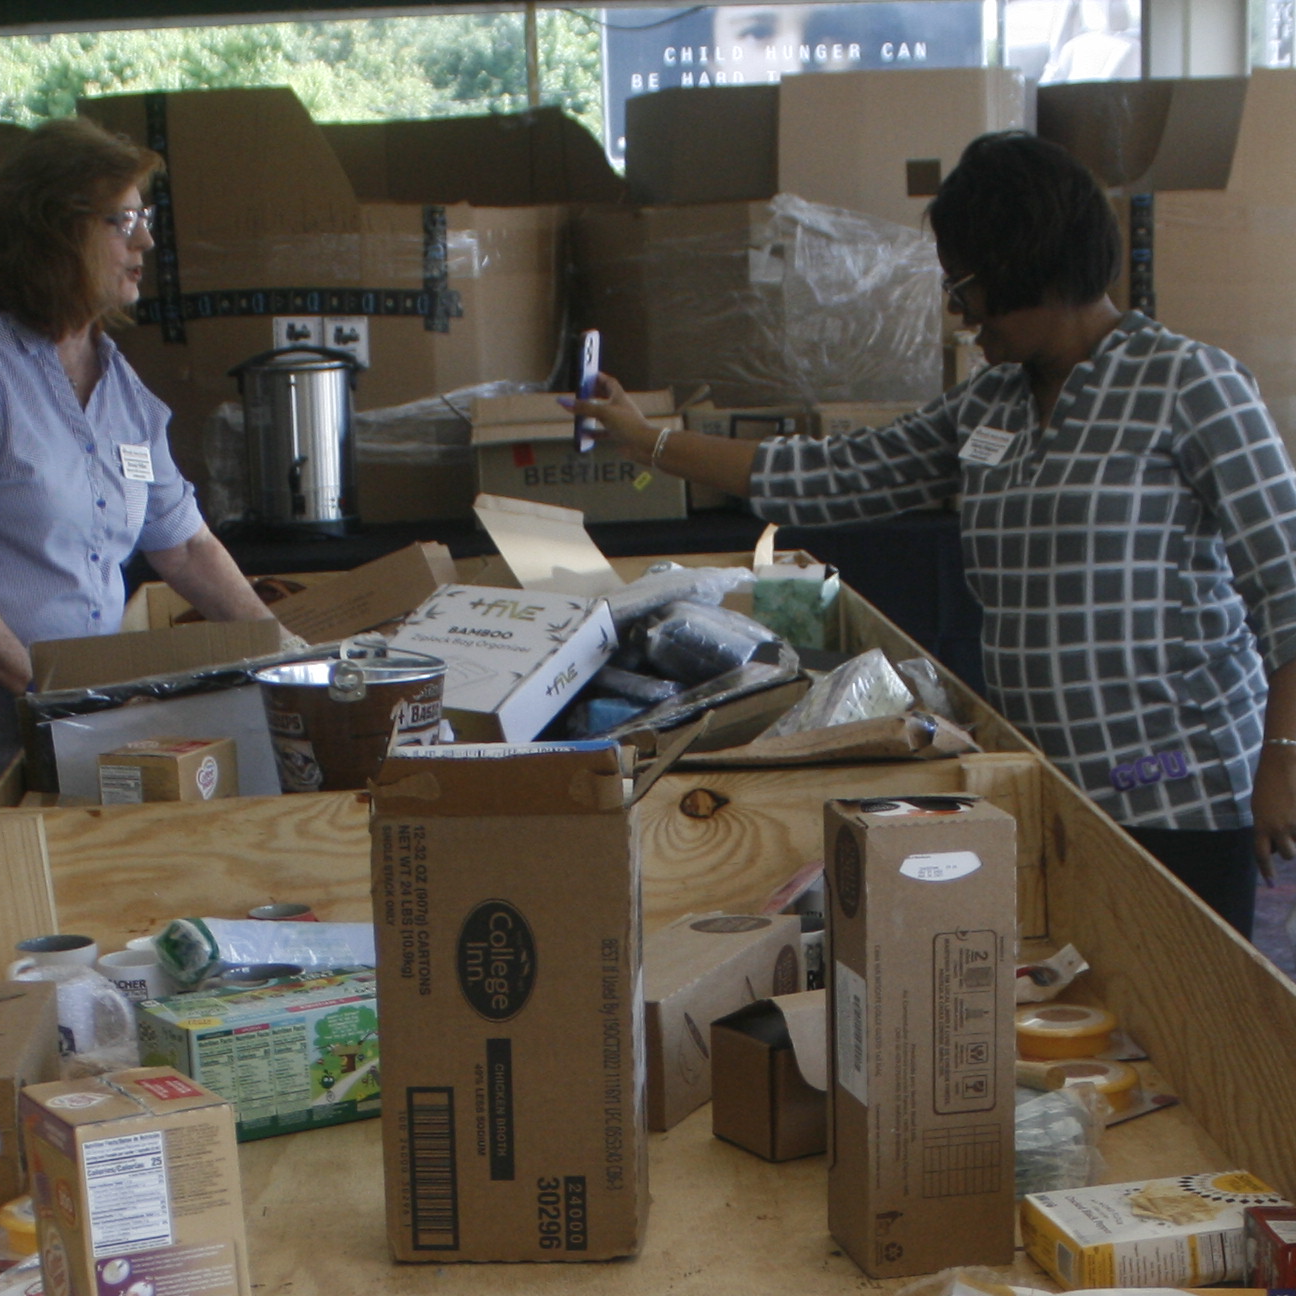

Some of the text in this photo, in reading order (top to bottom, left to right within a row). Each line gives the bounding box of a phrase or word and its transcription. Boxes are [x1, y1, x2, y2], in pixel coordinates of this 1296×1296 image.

[664, 42, 928, 66] CHILD HUNGER CAN
[631, 73, 660, 92] BE
[524, 461, 636, 487] BESTIER
[448, 625, 513, 639] BAMBOO
[1109, 751, 1187, 792] GCU
[398, 824, 412, 851] NET
[415, 825, 426, 860] 12-32
[399, 856, 412, 877] WT
[415, 864, 427, 884] OZ
[384, 864, 395, 897] STACK
[400, 881, 413, 896] 24
[385, 900, 395, 926] ONLY
[401, 899, 413, 926] LBS
[466, 942, 488, 981] Inn
[485, 912, 514, 1010] College
[602, 938, 618, 961] BEST
[417, 930, 431, 996] CARTONS
[602, 976, 619, 1000] Used
[599, 1002, 619, 1016] By
[495, 1063, 507, 1157] CHICKEN BROTH
[476, 1116, 486, 1156] SODIUM
[151, 1156, 163, 1167] 25
[537, 1177, 562, 1250] 30296
[568, 1183, 584, 1244] 24000
